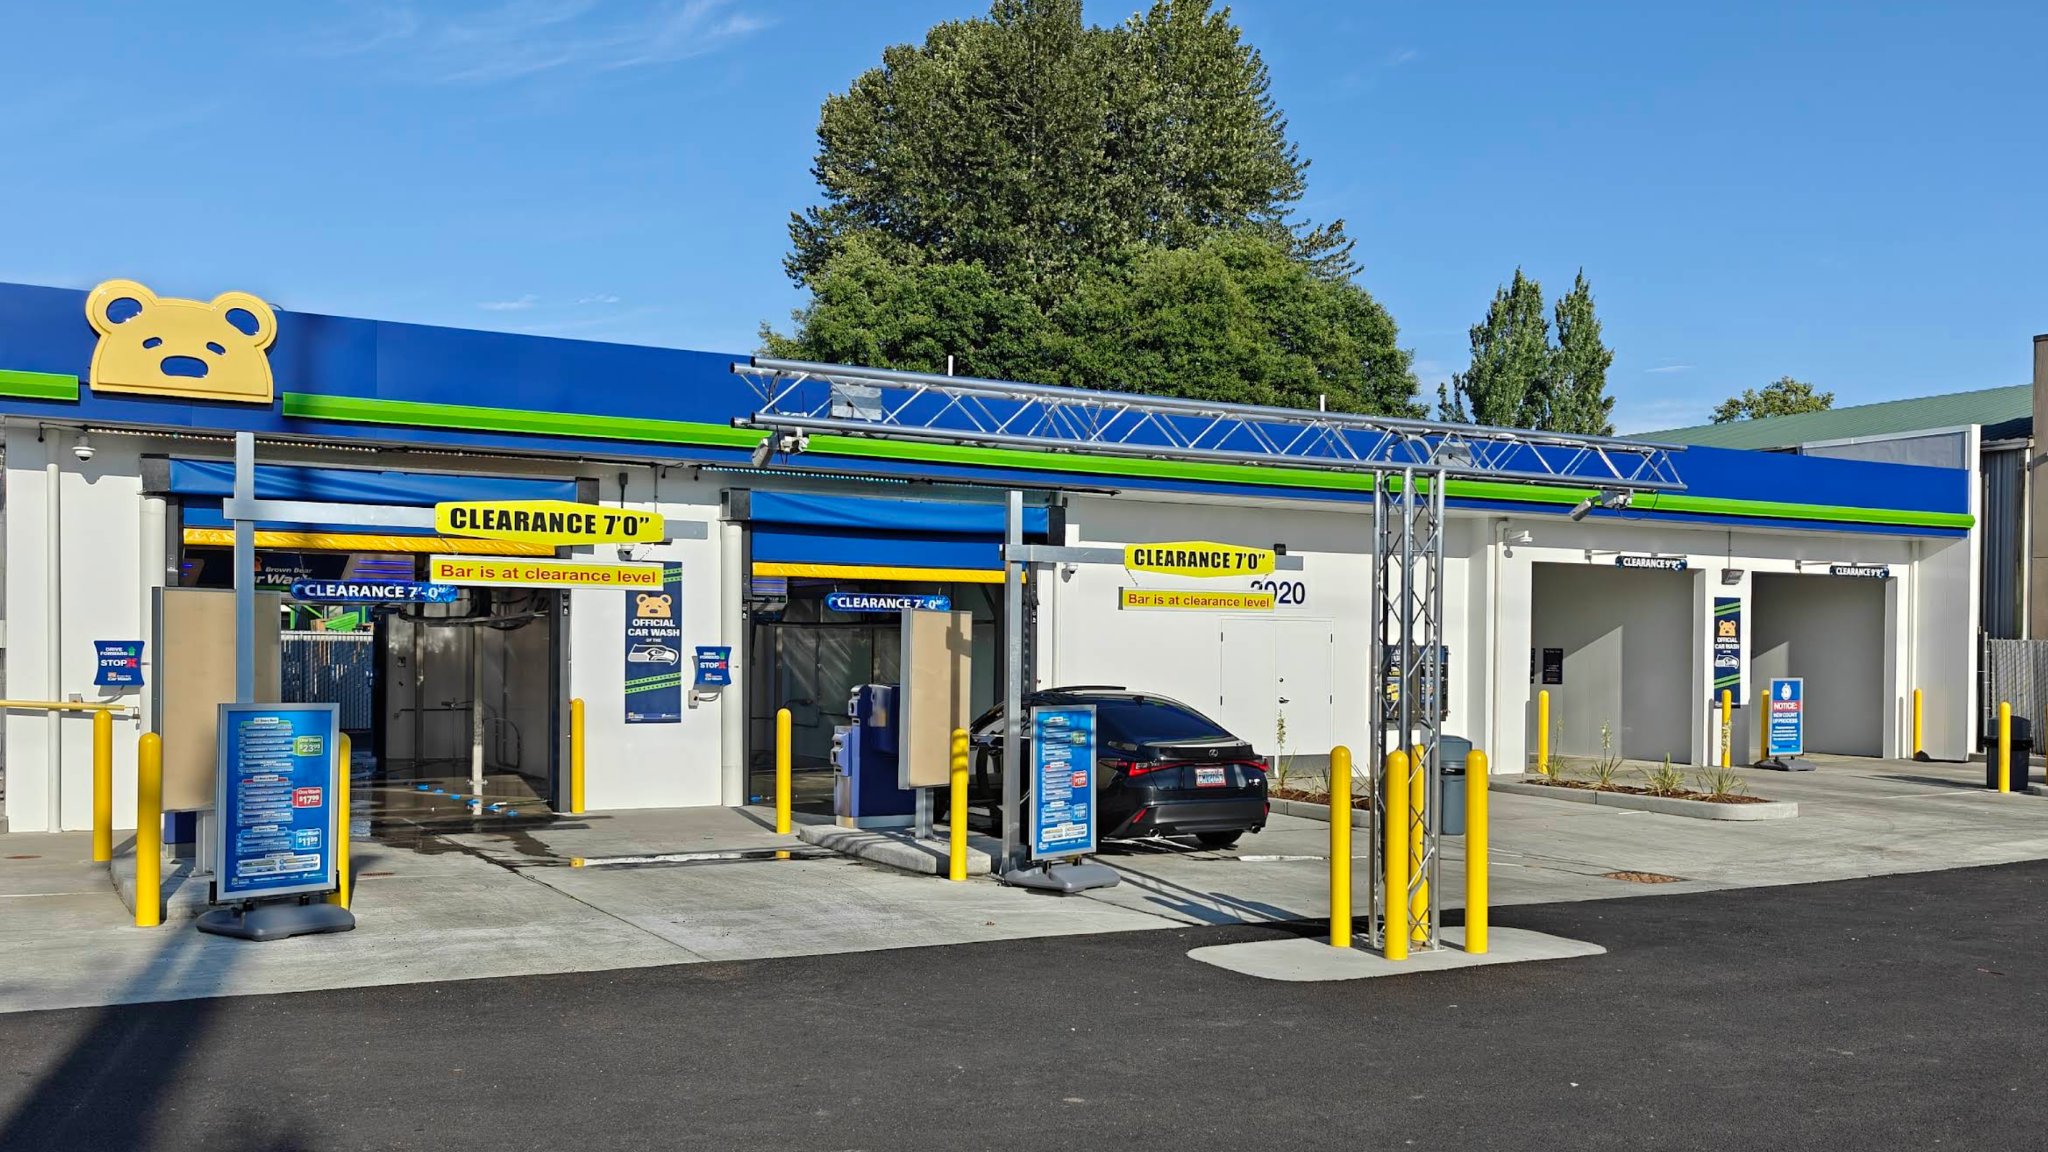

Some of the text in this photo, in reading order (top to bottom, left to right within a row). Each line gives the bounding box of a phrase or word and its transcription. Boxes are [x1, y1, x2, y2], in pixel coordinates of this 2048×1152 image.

[450, 507, 596, 534] CLEARANCE
[1134, 549, 1230, 568] CLEARANCE
[1623, 557, 1664, 568] CLEARANCE
[441, 564, 656, 583] Bar is at clearance level
[1836, 567, 1870, 576] CLEARANCE
[305, 584, 405, 598] CLEARANCE
[837, 597, 911, 609] CLEARANCE
[1128, 593, 1270, 608] Bar is at clearance level
[632, 618, 676, 627] OFFICIAL
[628, 628, 680, 637] CAR WASH
[100, 659, 127, 667] STOP
